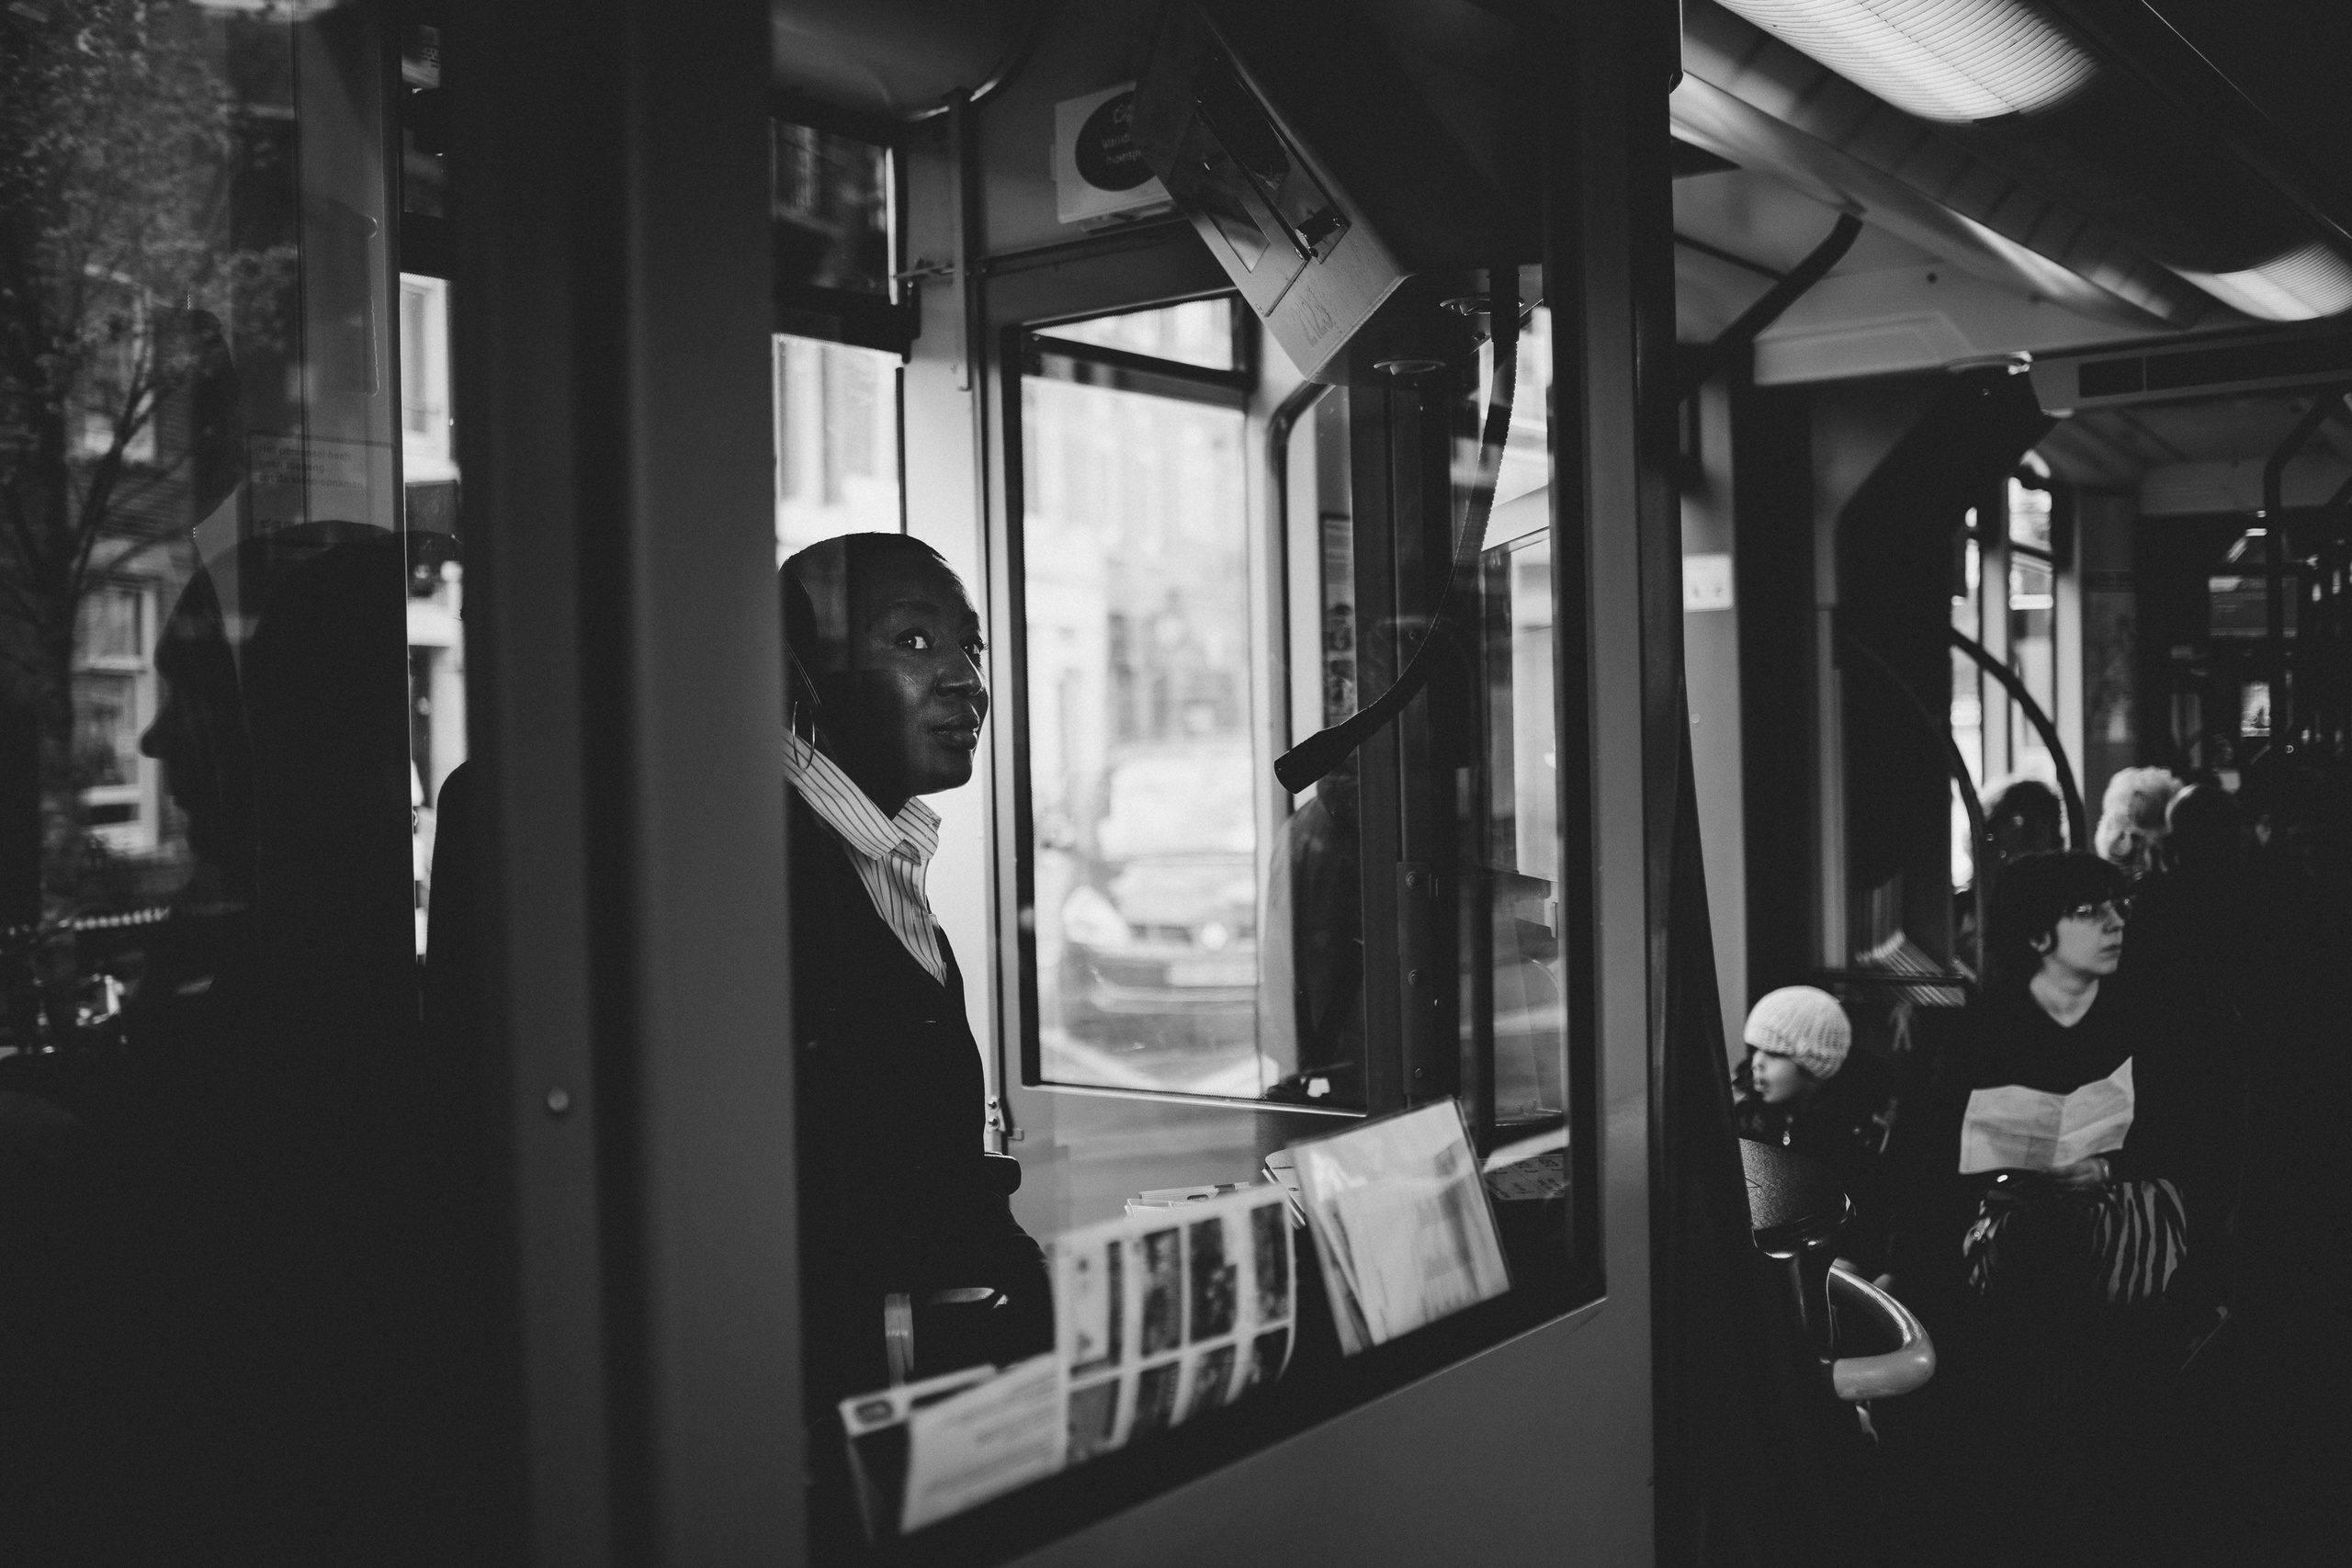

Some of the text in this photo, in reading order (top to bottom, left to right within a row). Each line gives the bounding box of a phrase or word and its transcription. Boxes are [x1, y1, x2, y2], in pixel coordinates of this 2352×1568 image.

[258, 443, 352, 461] Het personeel heeft
[258, 459, 325, 474] geen toegang
[277, 473, 289, 483] de
